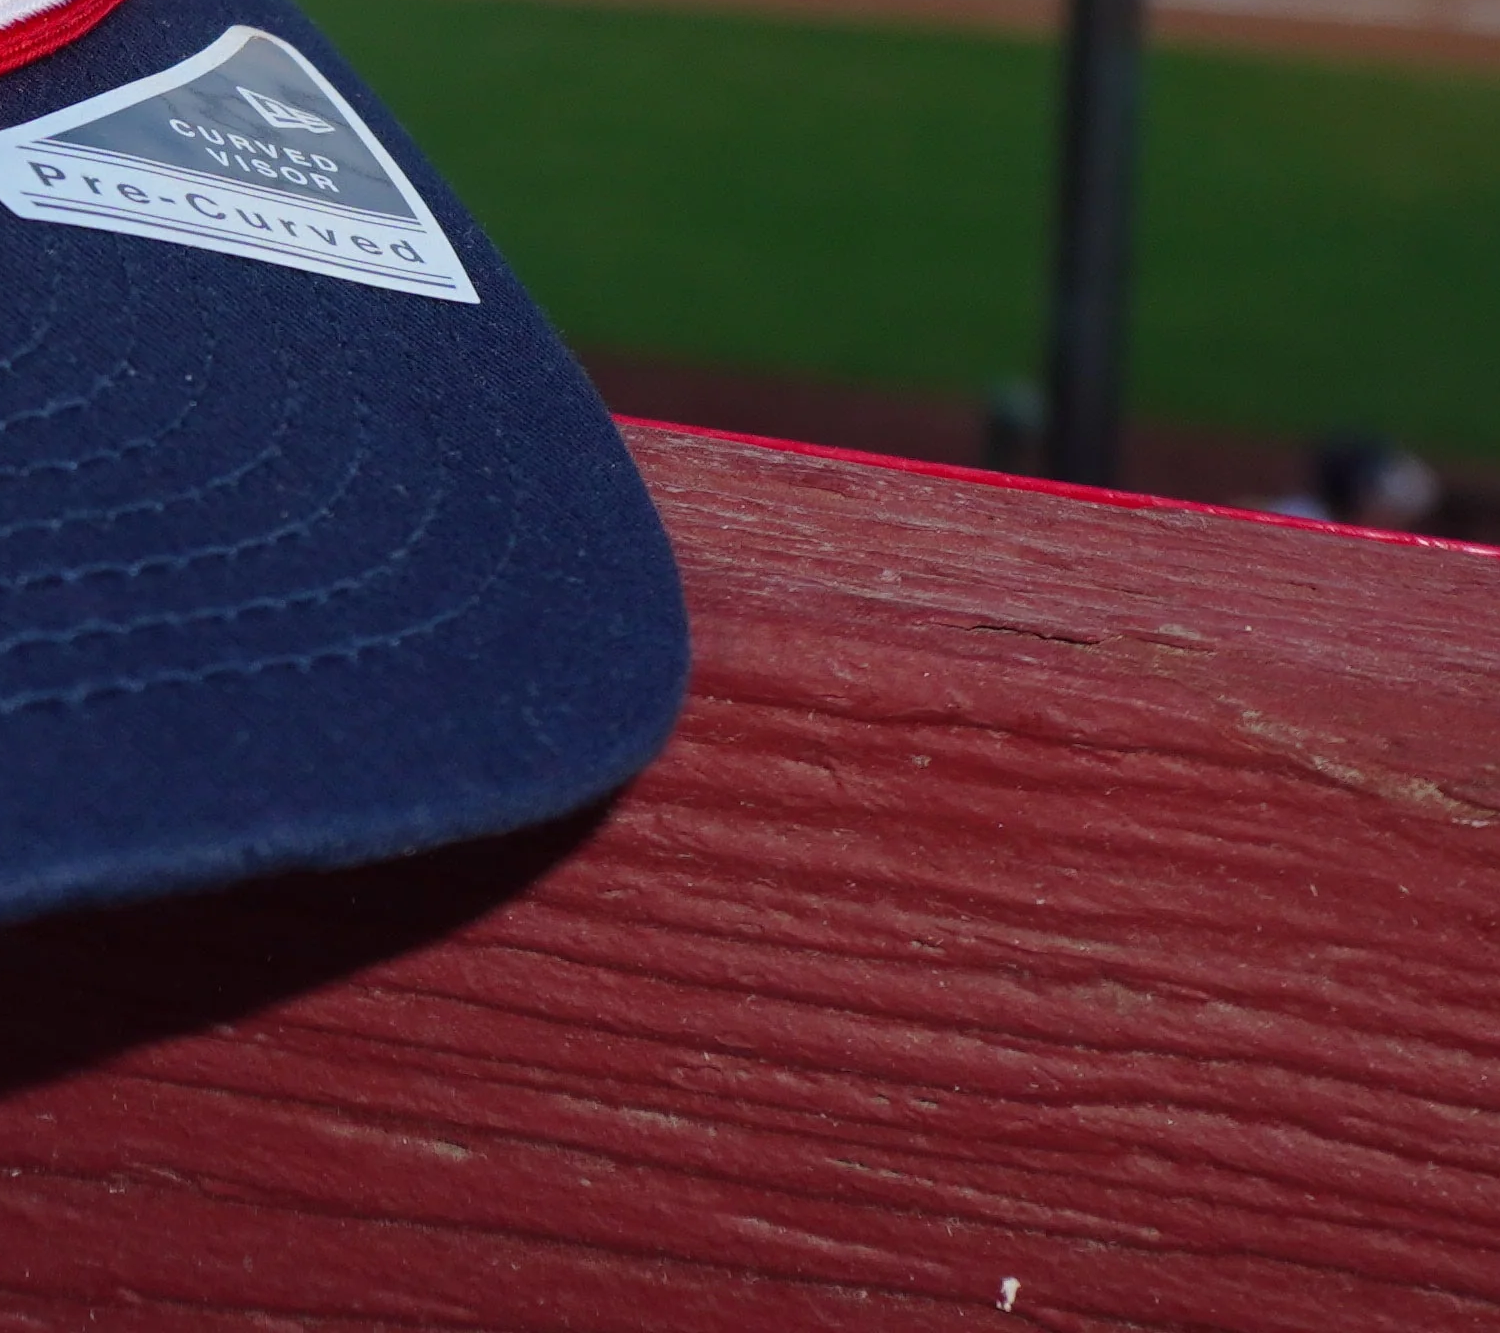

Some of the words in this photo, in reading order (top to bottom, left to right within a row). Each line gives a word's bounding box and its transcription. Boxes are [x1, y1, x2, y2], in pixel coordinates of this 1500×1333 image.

[168, 118, 340, 174] CURVED
[205, 147, 341, 194] VISOR
[27, 161, 426, 265] Pre-Curved
